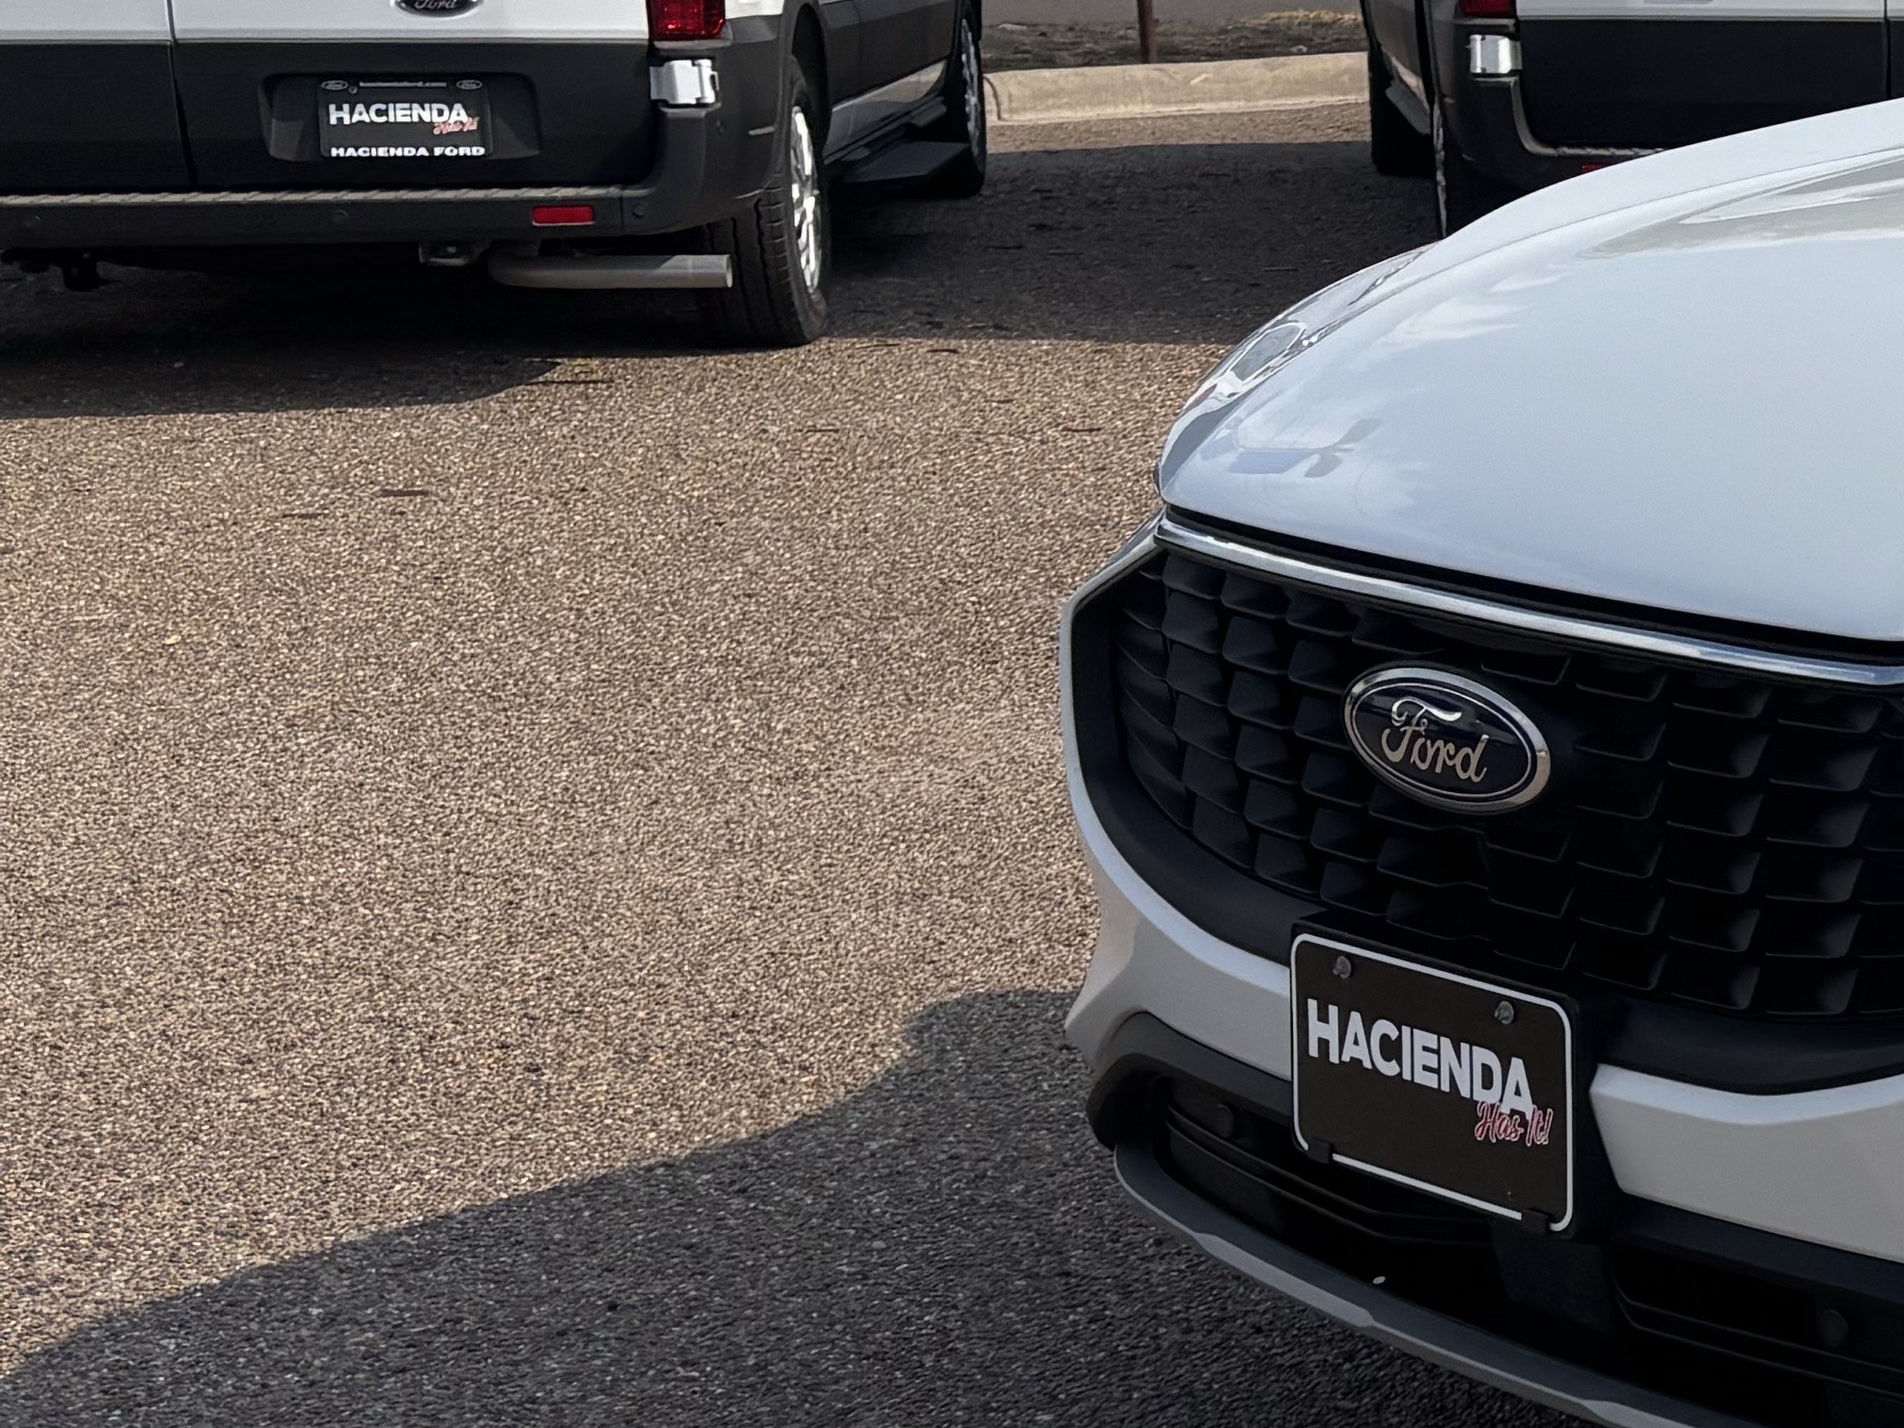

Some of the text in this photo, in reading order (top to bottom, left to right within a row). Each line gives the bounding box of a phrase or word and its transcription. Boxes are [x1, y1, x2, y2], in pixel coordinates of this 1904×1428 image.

[328, 103, 469, 125] HACIENDA
[330, 146, 486, 158] HACIENDA FORD
[1381, 696, 1490, 783] Ford
[1307, 998, 1533, 1121] HACIENDA
[1474, 1100, 1555, 1147] Has It!
